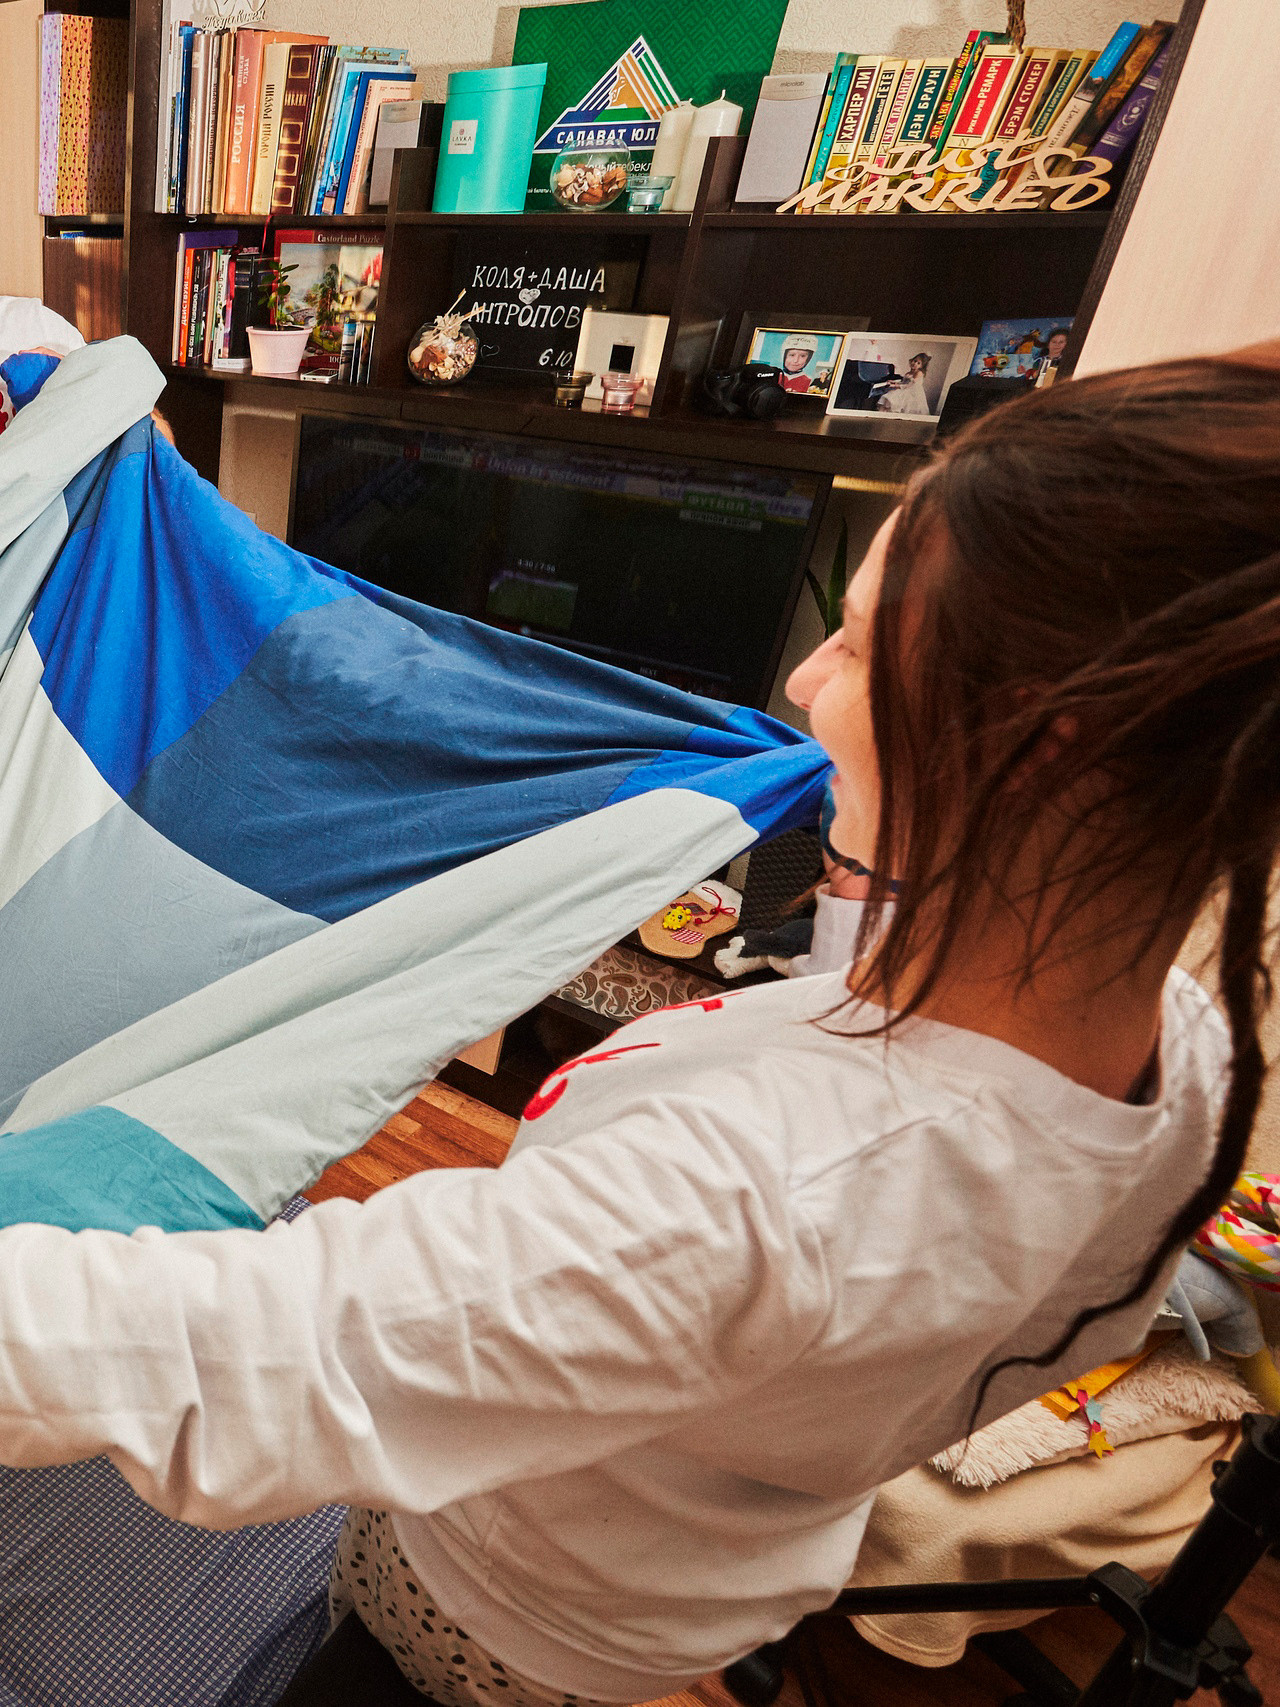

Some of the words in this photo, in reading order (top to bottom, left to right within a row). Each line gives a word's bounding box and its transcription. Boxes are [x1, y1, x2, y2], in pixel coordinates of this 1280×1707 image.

[237, 56, 245, 88] ВЕЛИКАЯ
[242, 58, 250, 84] СУДЬБА
[877, 72, 895, 99] ГЕТЕ
[978, 60, 1003, 99] РЕМАРК
[263, 84, 275, 119] РОССИИ
[840, 93, 864, 140] ХАРПЕР
[855, 71, 872, 89] ЛИ
[883, 118, 897, 141] ЧАК
[891, 74, 914, 118] ПАЛАНИК
[908, 114, 925, 138] ДЭН
[918, 70, 941, 109] БРАУН
[930, 103, 952, 140] ЗАГАДКА
[945, 68, 963, 102] ШКОЛЬНОГО
[958, 41, 973, 68] ПОДВАЛА
[1004, 106, 1025, 135] БРЭМ
[1020, 63, 1043, 104] СТОКЕР
[967, 119, 977, 134] ЭРИХ
[973, 99, 984, 119] МАРИЯ
[231, 104, 246, 164] РОССИЯ
[260, 123, 272, 159] ГОРОДА
[556, 128, 627, 144] САЛАВАТ
[630, 127, 658, 142] ЮЛ
[776, 175, 1111, 212] MARRIED
[317, 233, 357, 243] Castorland
[181, 281, 189, 326] ДЕЙСТВУЙ!
[468, 301, 580, 329] АНТРОПОВ
[538, 348, 573, 367] 6.10.
[530, 464, 611, 487] Inestment
